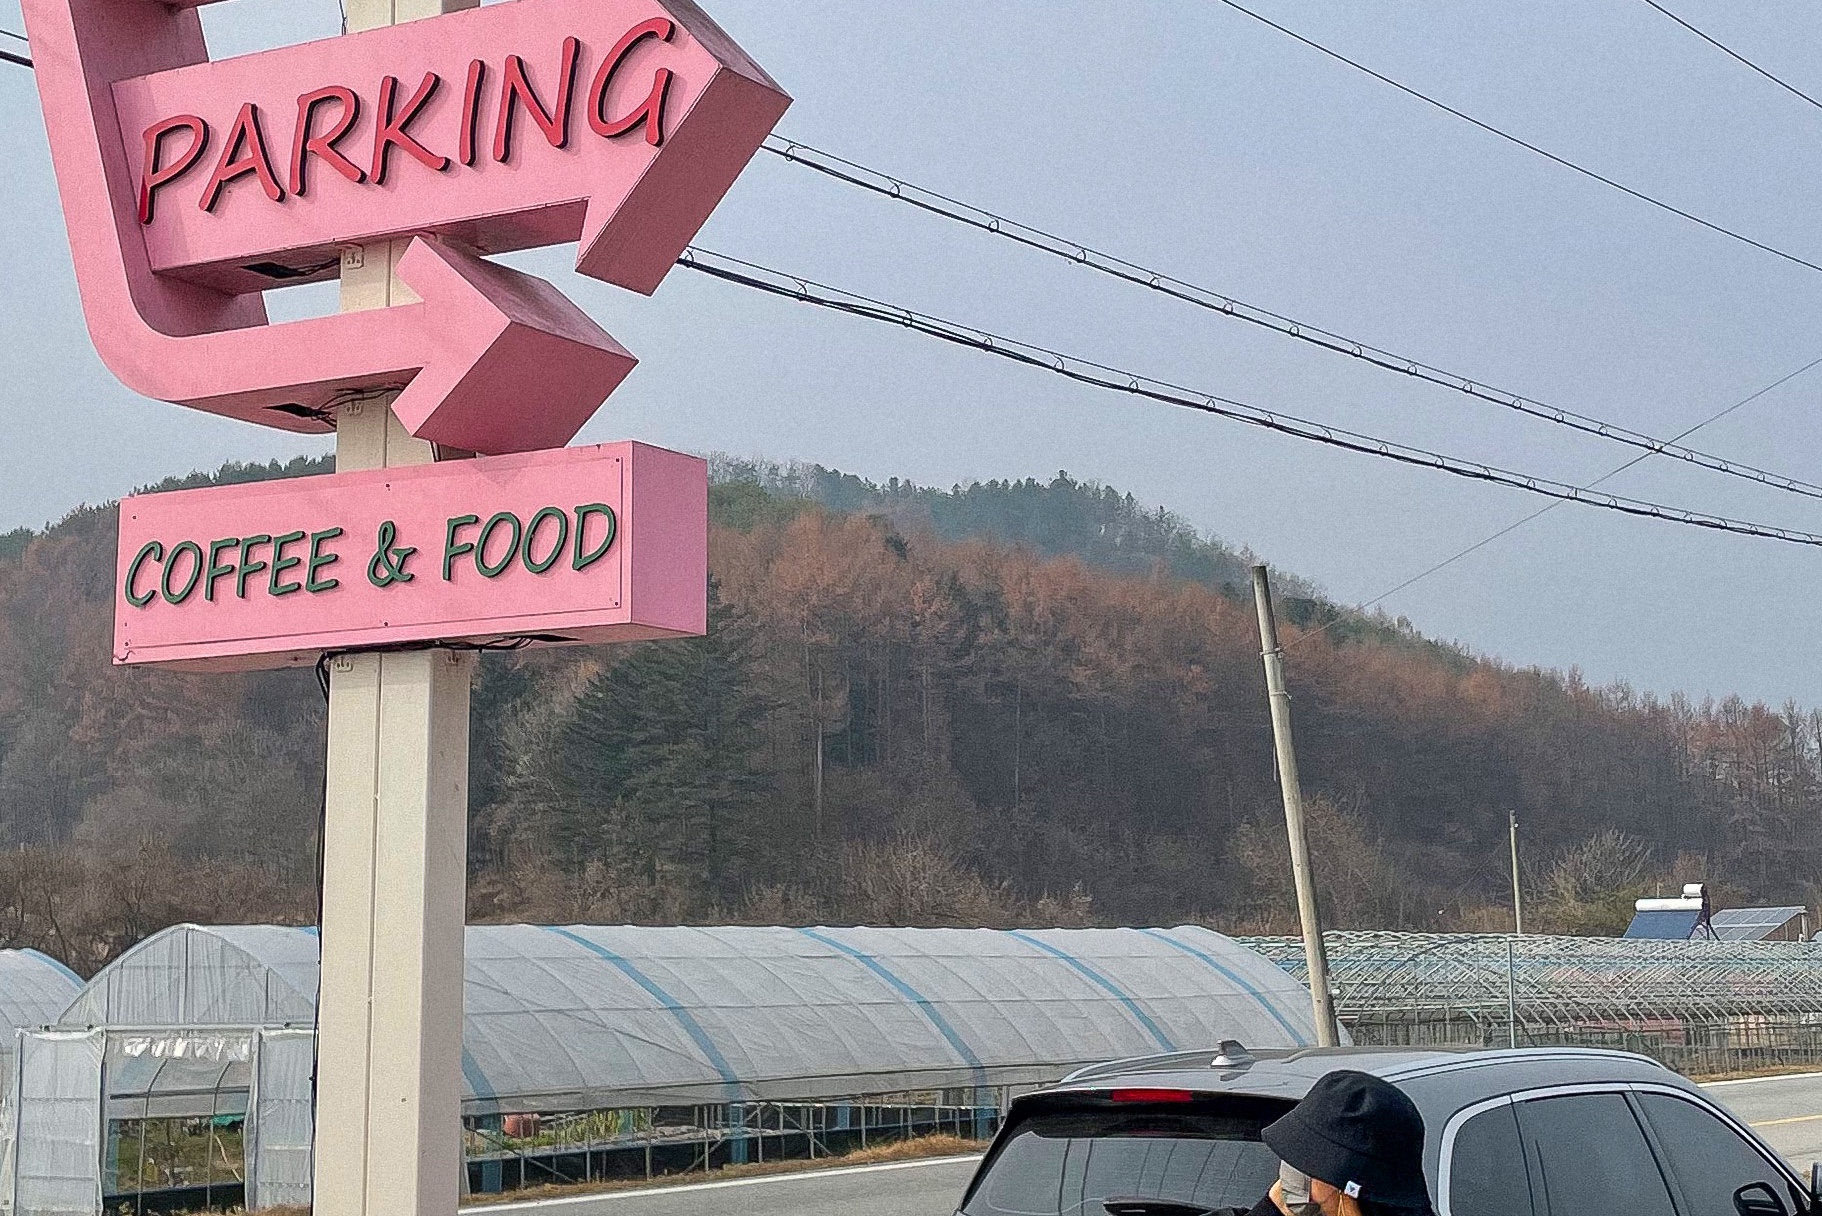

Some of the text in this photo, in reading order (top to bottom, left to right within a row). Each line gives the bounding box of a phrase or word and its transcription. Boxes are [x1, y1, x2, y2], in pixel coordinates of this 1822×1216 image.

[139, 17, 675, 225] PARKING
[125, 503, 616, 607] COFFEE & FOOD
